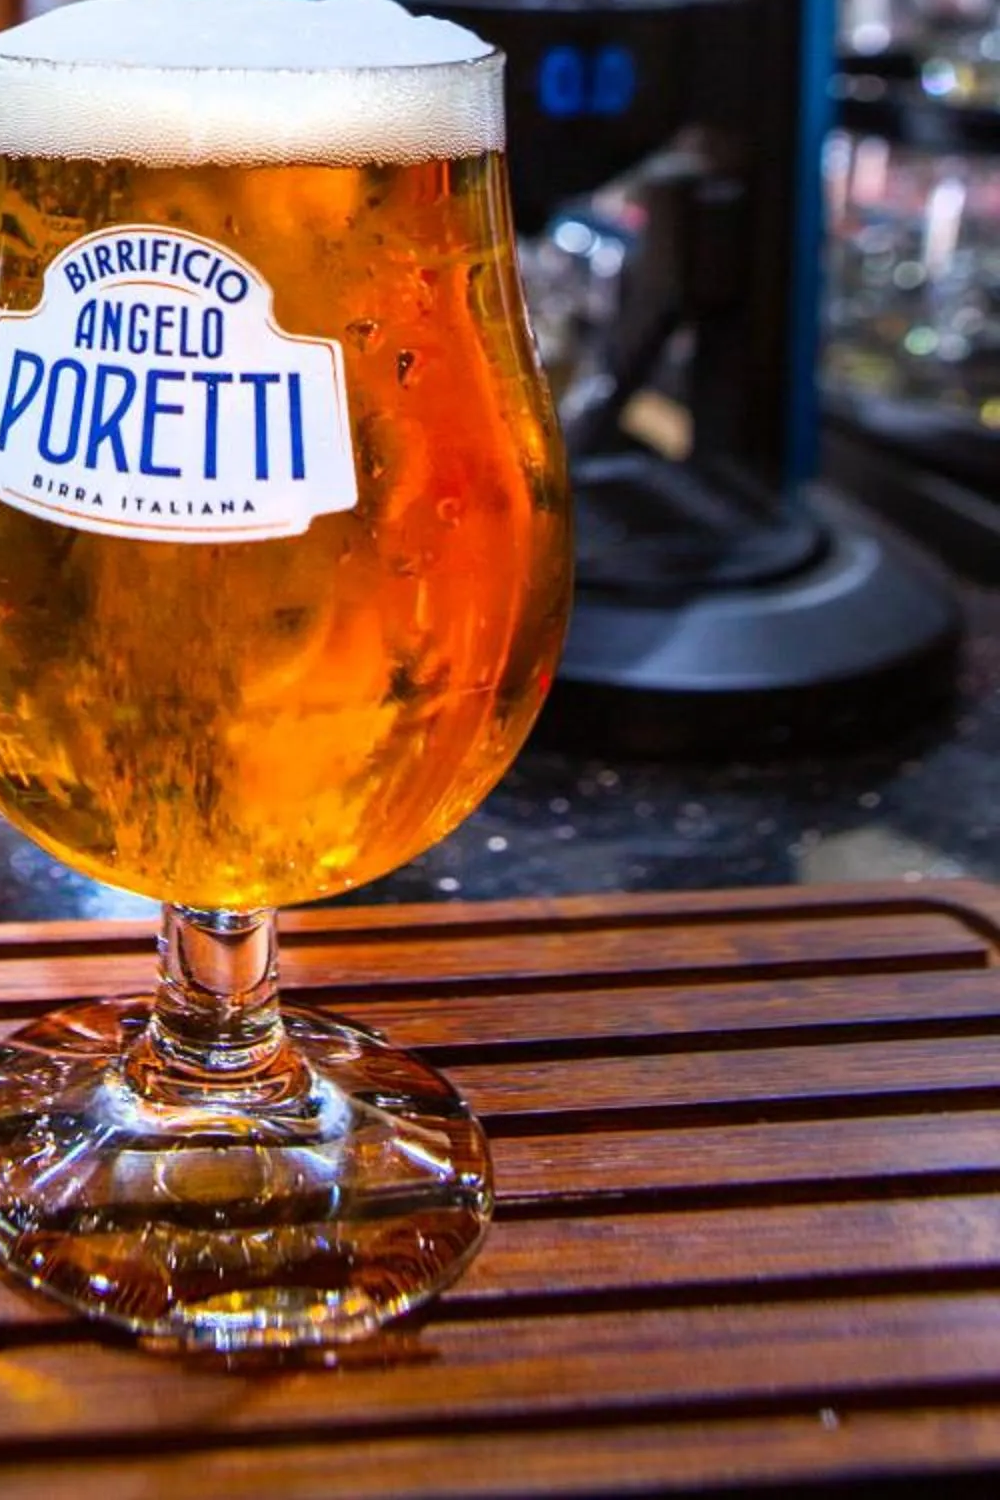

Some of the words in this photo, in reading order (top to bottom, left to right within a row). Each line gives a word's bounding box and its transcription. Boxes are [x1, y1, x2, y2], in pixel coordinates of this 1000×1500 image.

[62, 238, 250, 304] BIRRIFICIO
[74, 299, 224, 359] ANGELO
[31, 474, 104, 506] BIRRA
[120, 495, 257, 515] ITALIANA
